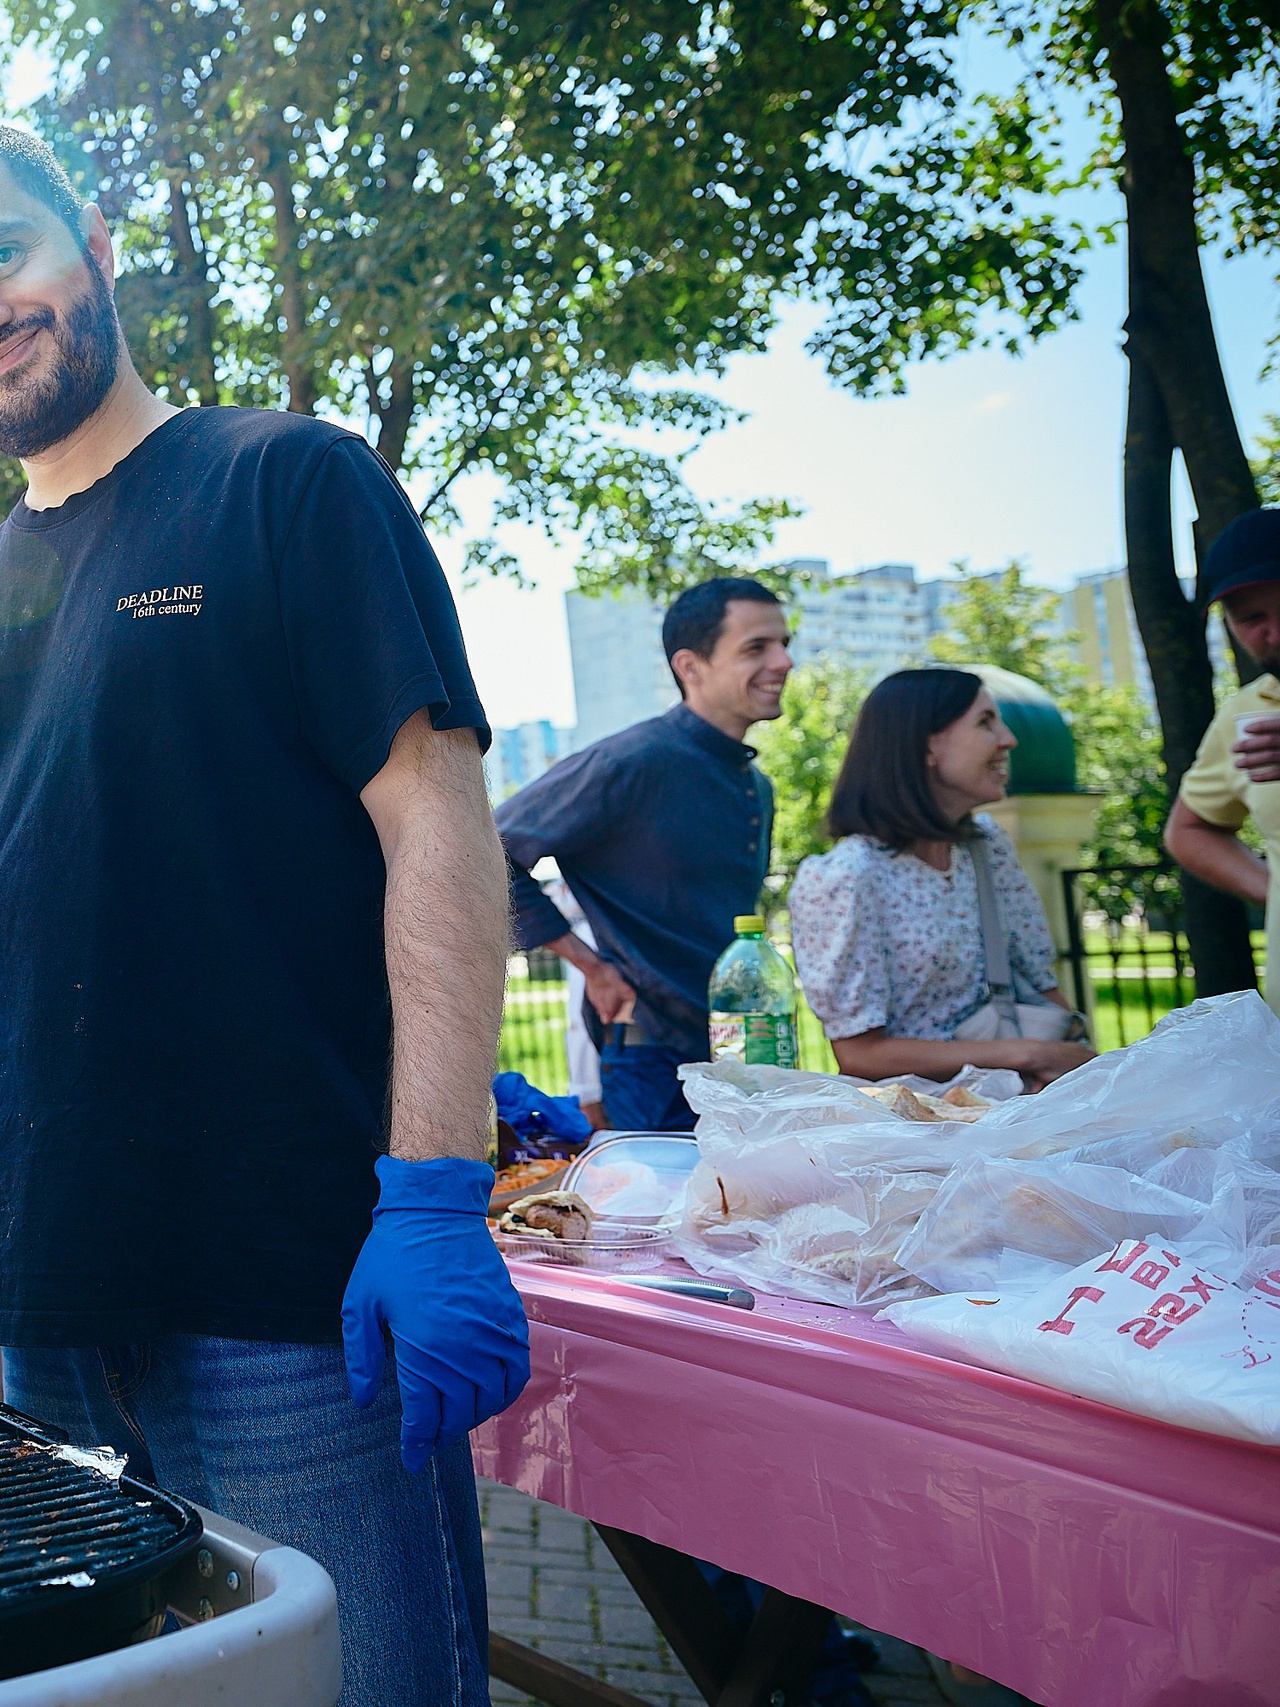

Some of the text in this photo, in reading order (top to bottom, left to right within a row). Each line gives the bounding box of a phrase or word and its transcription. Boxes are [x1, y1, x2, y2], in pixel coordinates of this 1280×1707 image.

[116, 585, 203, 612] DEADLINE
[132, 603, 202, 619] 16th century
